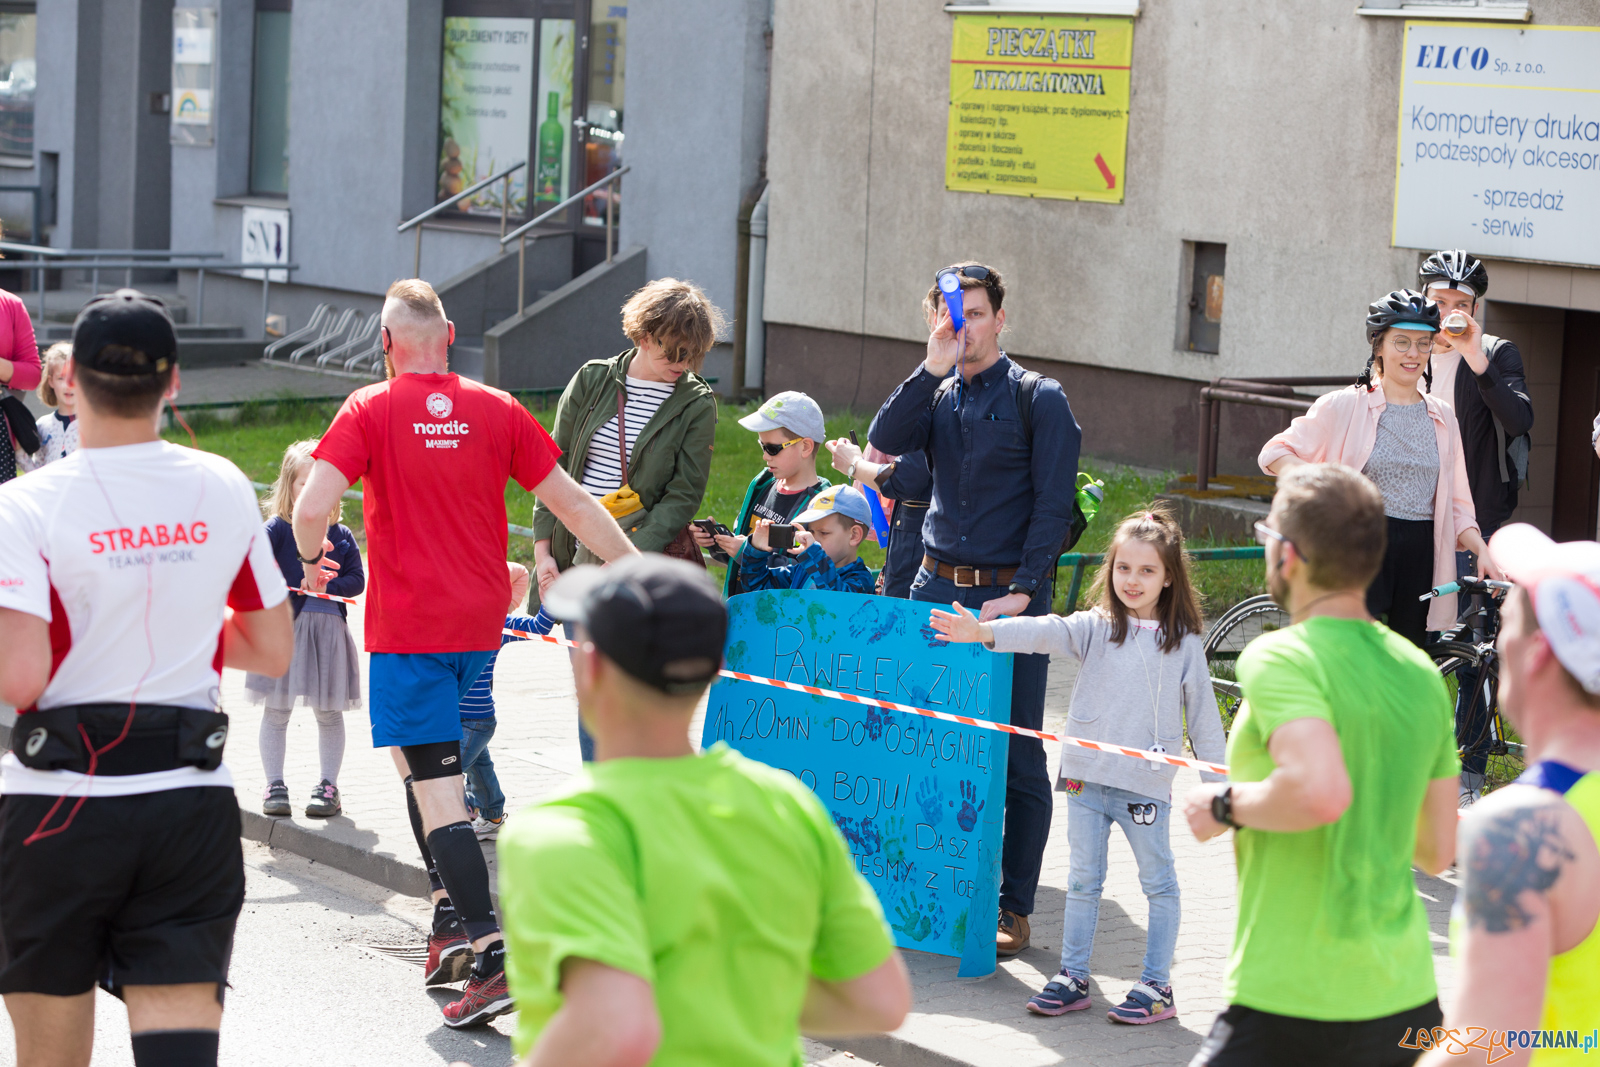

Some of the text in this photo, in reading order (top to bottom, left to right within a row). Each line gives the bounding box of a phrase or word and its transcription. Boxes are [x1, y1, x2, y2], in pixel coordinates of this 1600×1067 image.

[449, 29, 529, 44] SUPLEMENTY DIETY
[986, 27, 1097, 62] PIECZĄTKI
[1416, 45, 1546, 75] ELCO Sp. z o.o.
[973, 69, 1105, 95] INTROLIGATORNIA
[960, 102, 985, 113] oprawy
[991, 103, 1020, 114] naprawy
[1052, 106, 1068, 117] prac
[960, 115, 996, 127] kalendarzy
[959, 130, 984, 140] oprawy
[1412, 105, 1600, 143] Komputery druka
[1416, 139, 1517, 169] podzespoły
[995, 173, 1038, 184] zaproszenia
[1483, 188, 1564, 211] sprzedaż
[1482, 216, 1534, 238] serwis
[412, 420, 469, 435] nordic
[89, 521, 208, 555] STRABAG
[107, 551, 153, 569] TEAMS
[773, 625, 914, 700] PAWEŁEK
[832, 717, 866, 746] DO
[833, 771, 911, 819] BOJU!
[915, 823, 967, 859] DASZ
